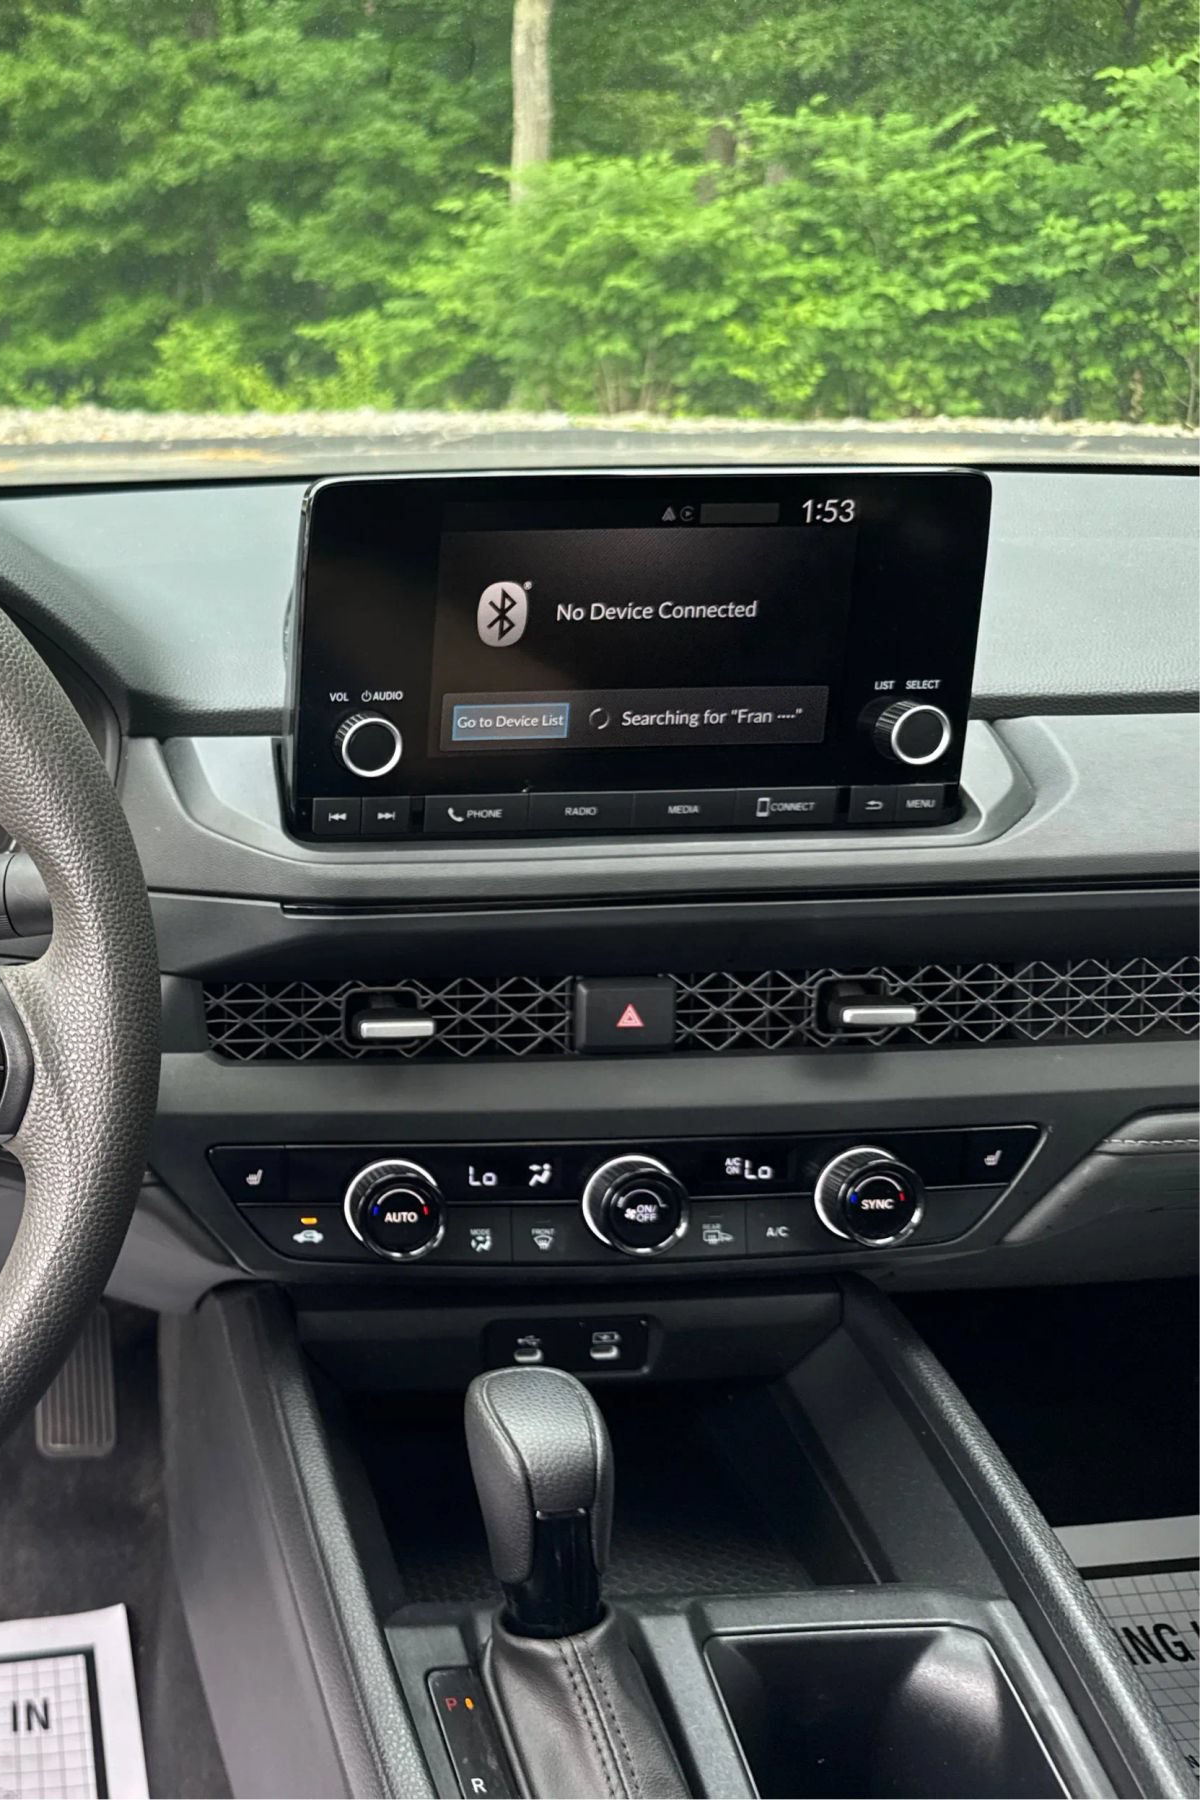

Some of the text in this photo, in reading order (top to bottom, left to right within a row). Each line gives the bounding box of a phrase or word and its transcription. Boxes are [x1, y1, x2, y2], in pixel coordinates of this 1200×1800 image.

[801, 499, 856, 523] 1:53
[556, 600, 758, 621] No Device Connected
[874, 680, 895, 690] LIST
[905, 679, 941, 690] SELECT
[330, 692, 349, 702] VOL
[373, 690, 404, 702] AUDIO
[457, 713, 564, 729] Go to Device List
[621, 709, 699, 728] Searching
[703, 709, 726, 725] for
[770, 801, 815, 812] CONNECT
[906, 798, 936, 809] MENU
[466, 809, 503, 820] PHONE
[565, 806, 597, 817] RADIO
[668, 804, 699, 815] MEDIA
[725, 1157, 742, 1166] A/C
[726, 1166, 741, 1175] ON
[744, 1160, 773, 1180] Lo
[468, 1165, 497, 1187] Lo
[636, 1204, 657, 1213] ON/
[861, 1199, 894, 1210] SYNC
[385, 1211, 419, 1223] AUTO
[636, 1213, 657, 1222] OFF
[532, 1228, 555, 1236] FRONT
[766, 1226, 789, 1237] A/C
[445, 1698, 457, 1711] P
[10, 1698, 51, 1732] IN
[471, 1778, 487, 1793] R
